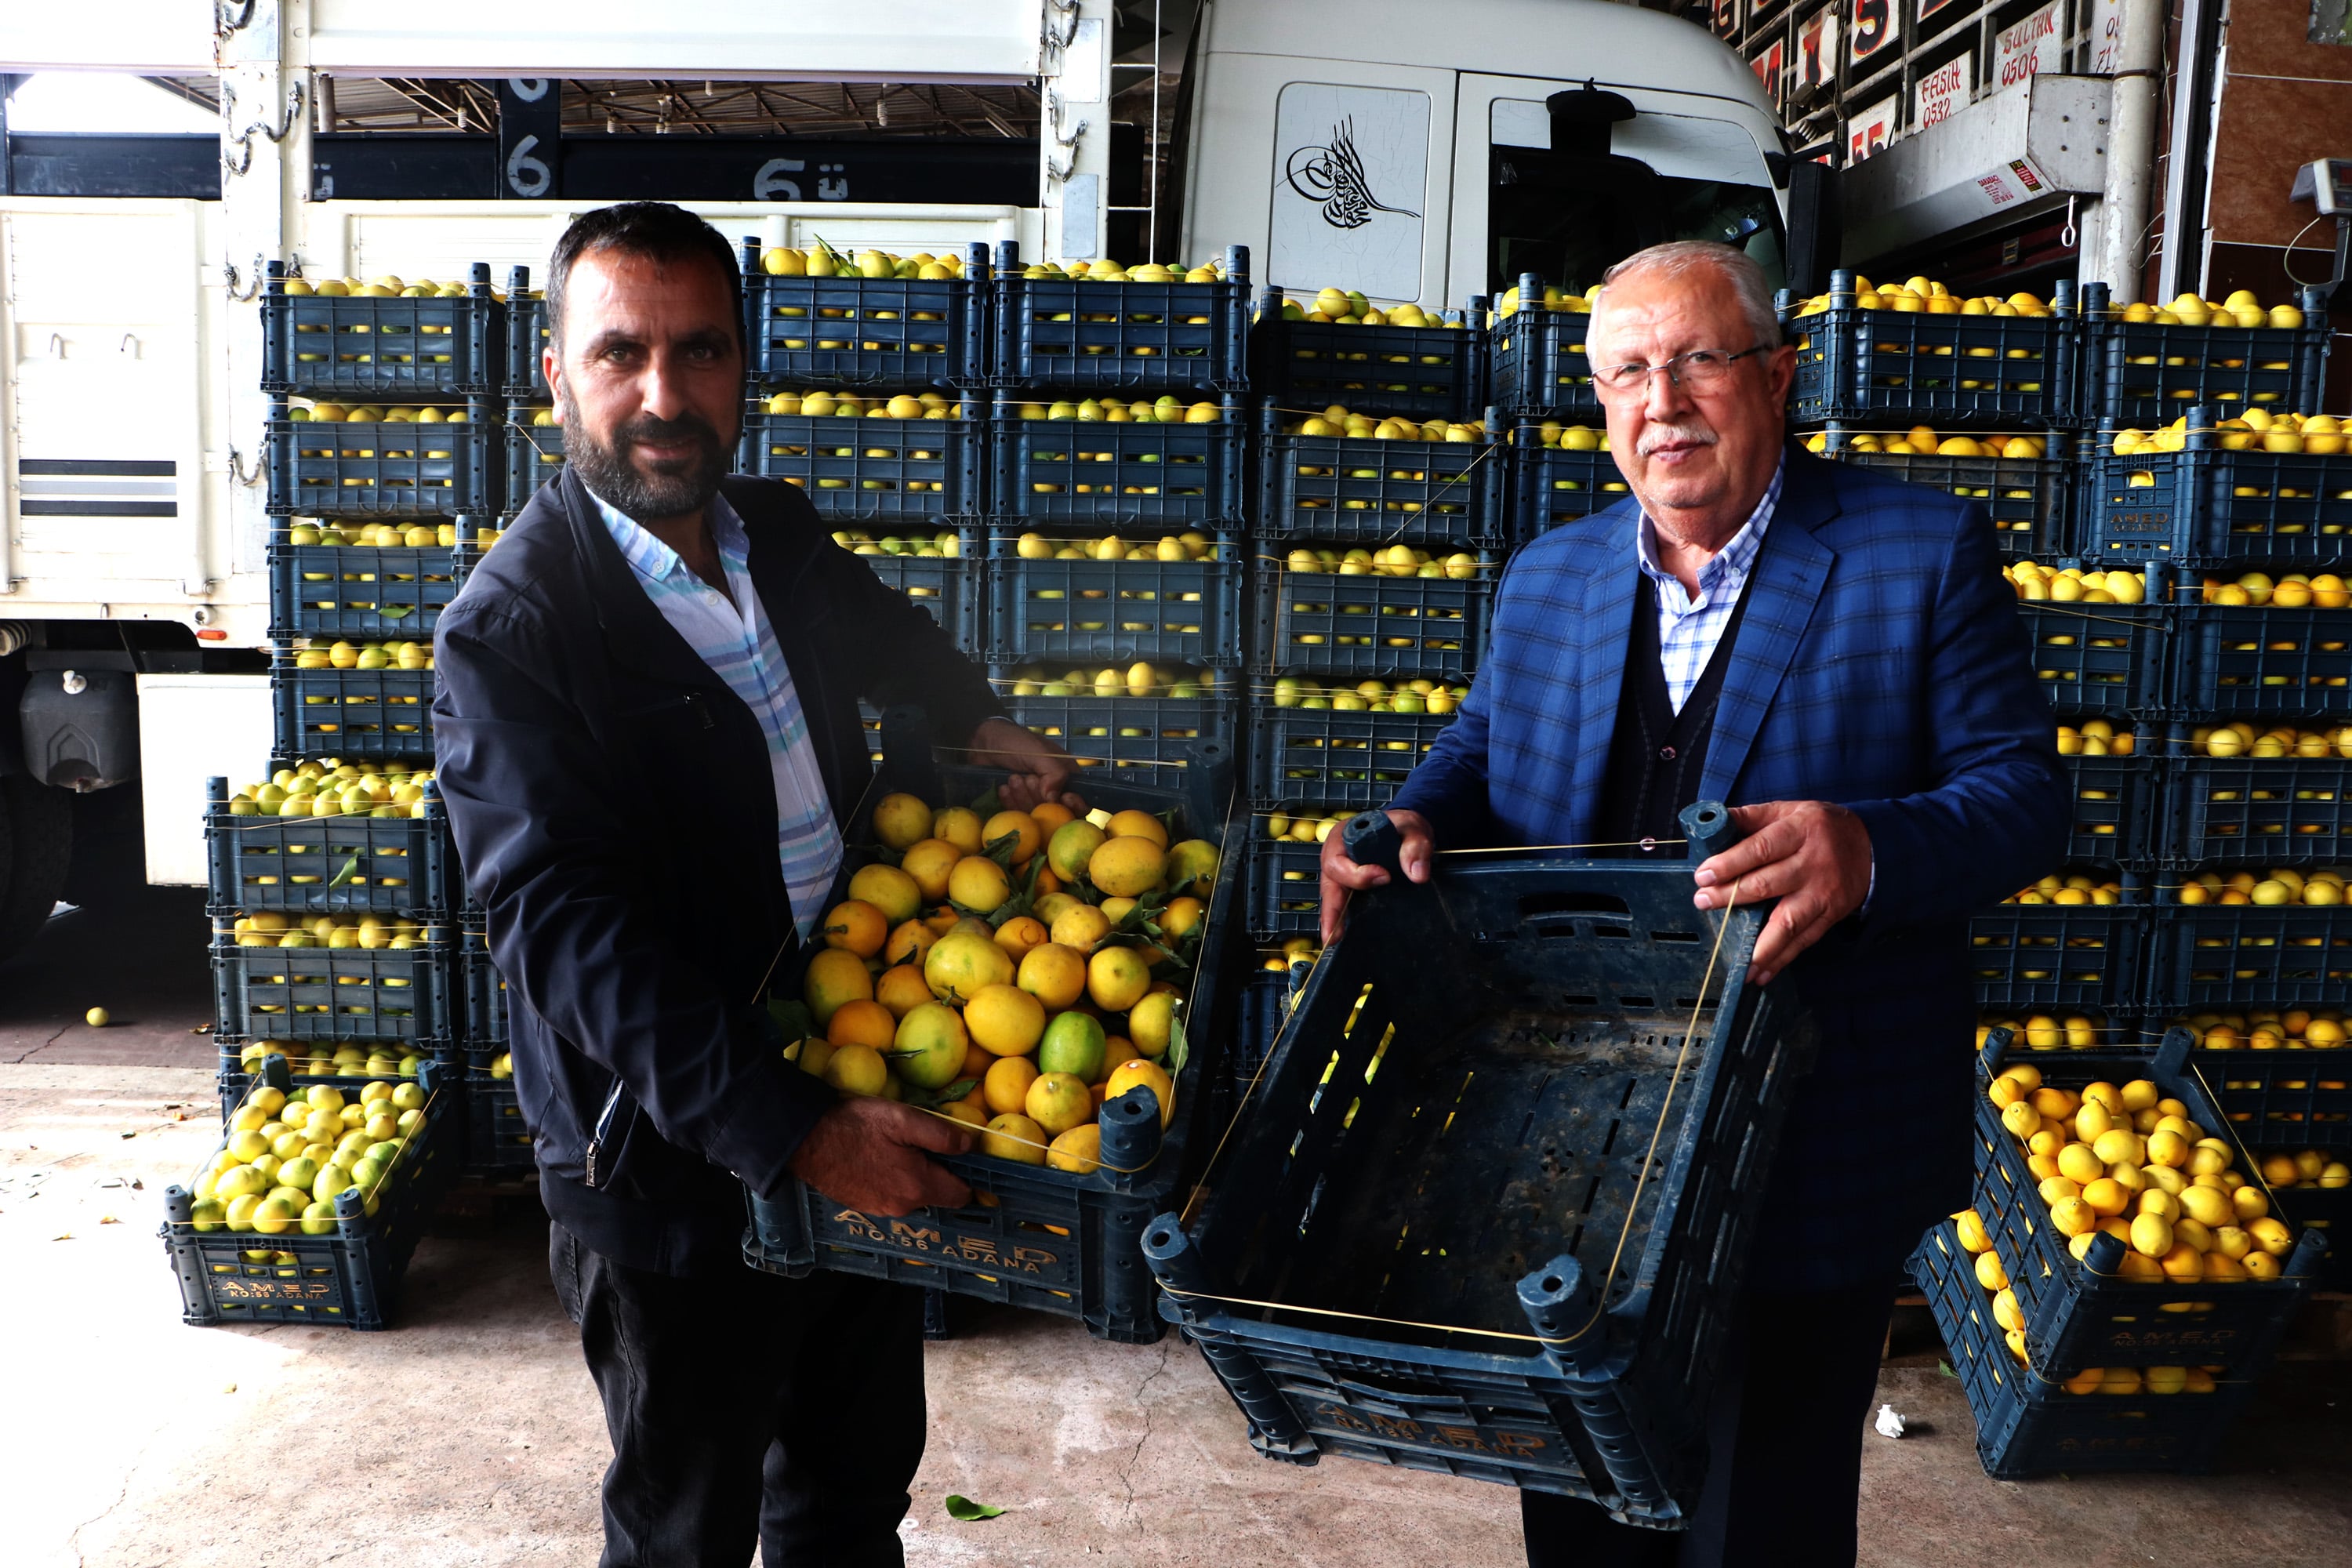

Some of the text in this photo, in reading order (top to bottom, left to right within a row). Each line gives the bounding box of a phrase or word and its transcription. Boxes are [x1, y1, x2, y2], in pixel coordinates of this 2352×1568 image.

[2003, 10, 2054, 54] SULTAN
[2002, 45, 2038, 86] 0506
[1923, 97, 1951, 129] 0532
[506, 134, 550, 198] 6
[2110, 513, 2169, 524] AMED
[833, 1210, 1058, 1264] AMED
[848, 1224, 1041, 1274] NO:56 ADANA
[221, 1281, 330, 1293] AMED
